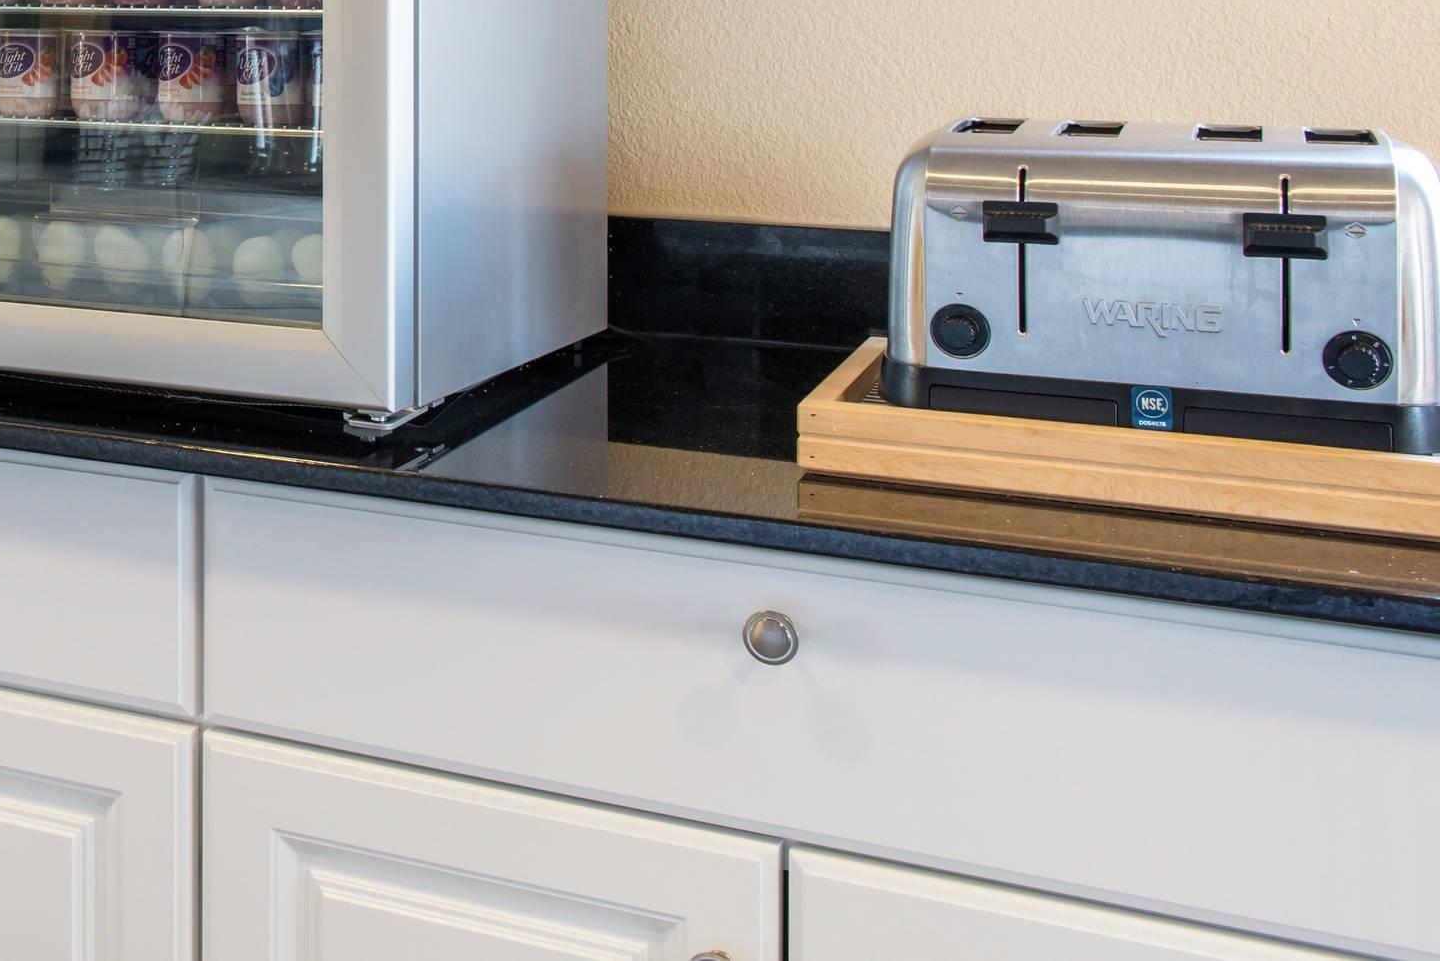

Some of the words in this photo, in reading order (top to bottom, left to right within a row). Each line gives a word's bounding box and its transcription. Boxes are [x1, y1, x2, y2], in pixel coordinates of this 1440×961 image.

[0, 49, 26, 66] Light
[72, 49, 95, 66] Light
[160, 51, 183, 68] Light
[1082, 297, 1225, 339] WARING
